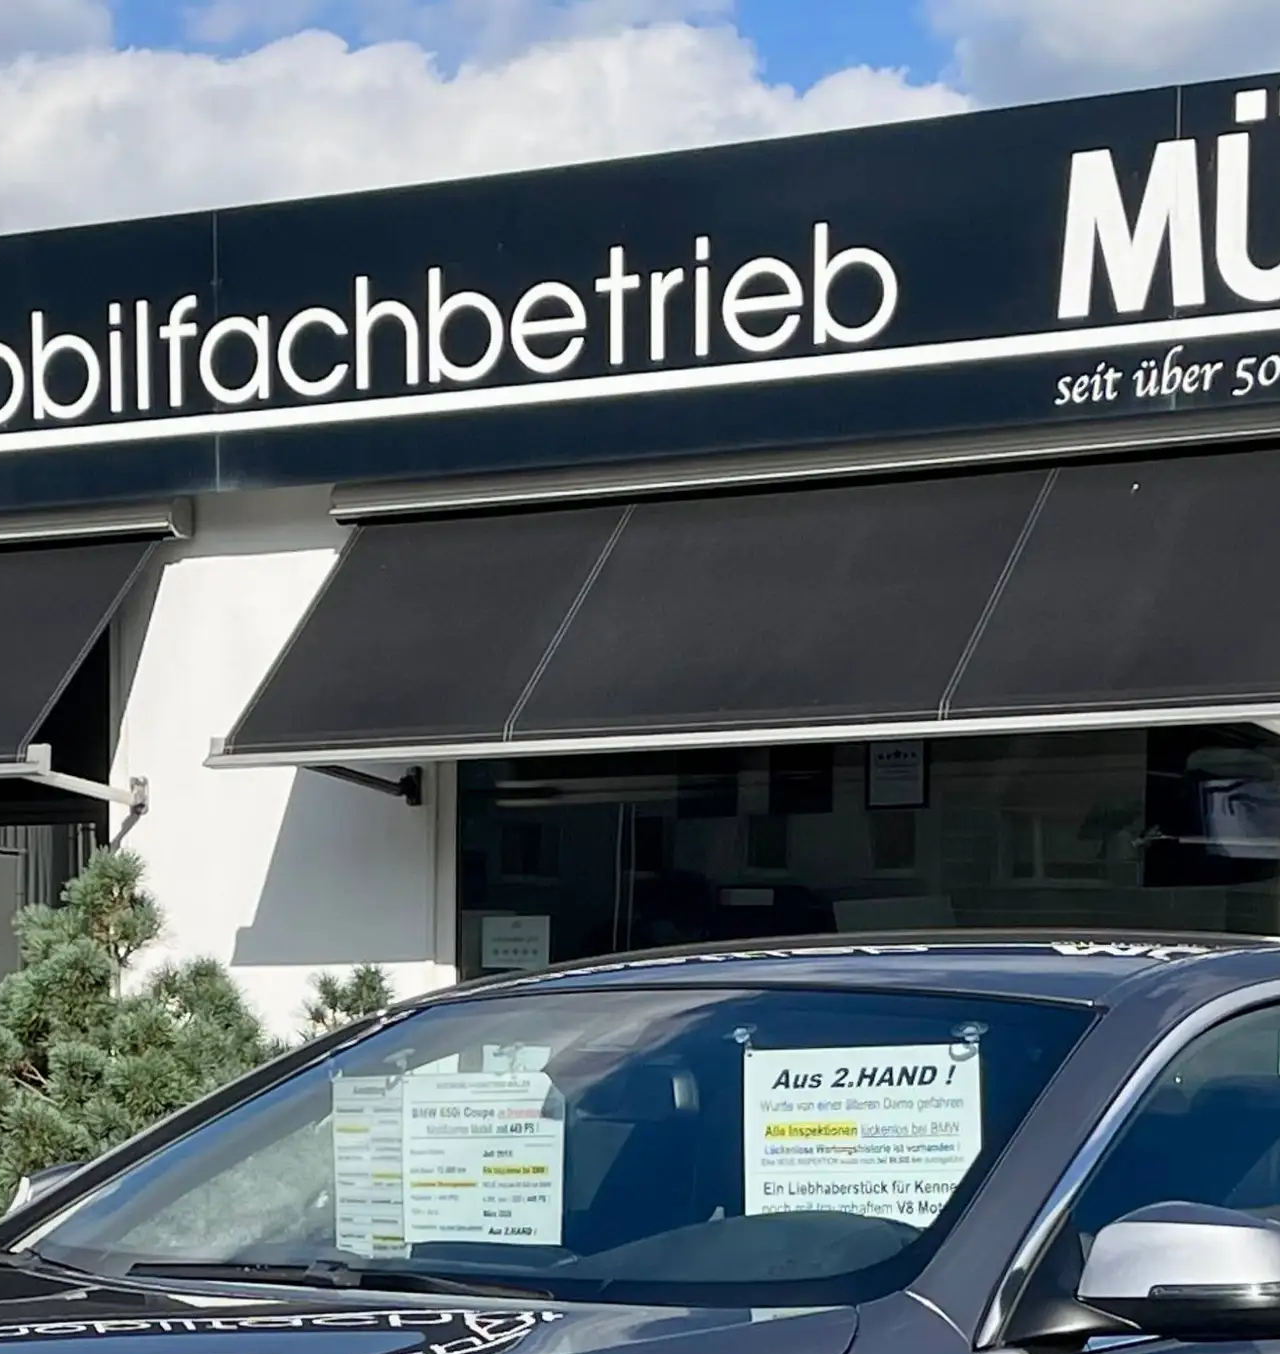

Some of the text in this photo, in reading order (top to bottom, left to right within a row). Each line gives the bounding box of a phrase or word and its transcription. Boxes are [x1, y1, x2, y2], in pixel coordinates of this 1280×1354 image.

[1054, 361, 1122, 406] seit
[1132, 345, 1223, 398] über
[771, 1065, 956, 1089] Aus 2.HAND !
[917, 1096, 964, 1113] gefahren
[788, 1123, 858, 1138] Inspektionen
[763, 1179, 956, 1196] Ein Liebhaberstück für Kenne
[896, 1200, 914, 1214] V8
